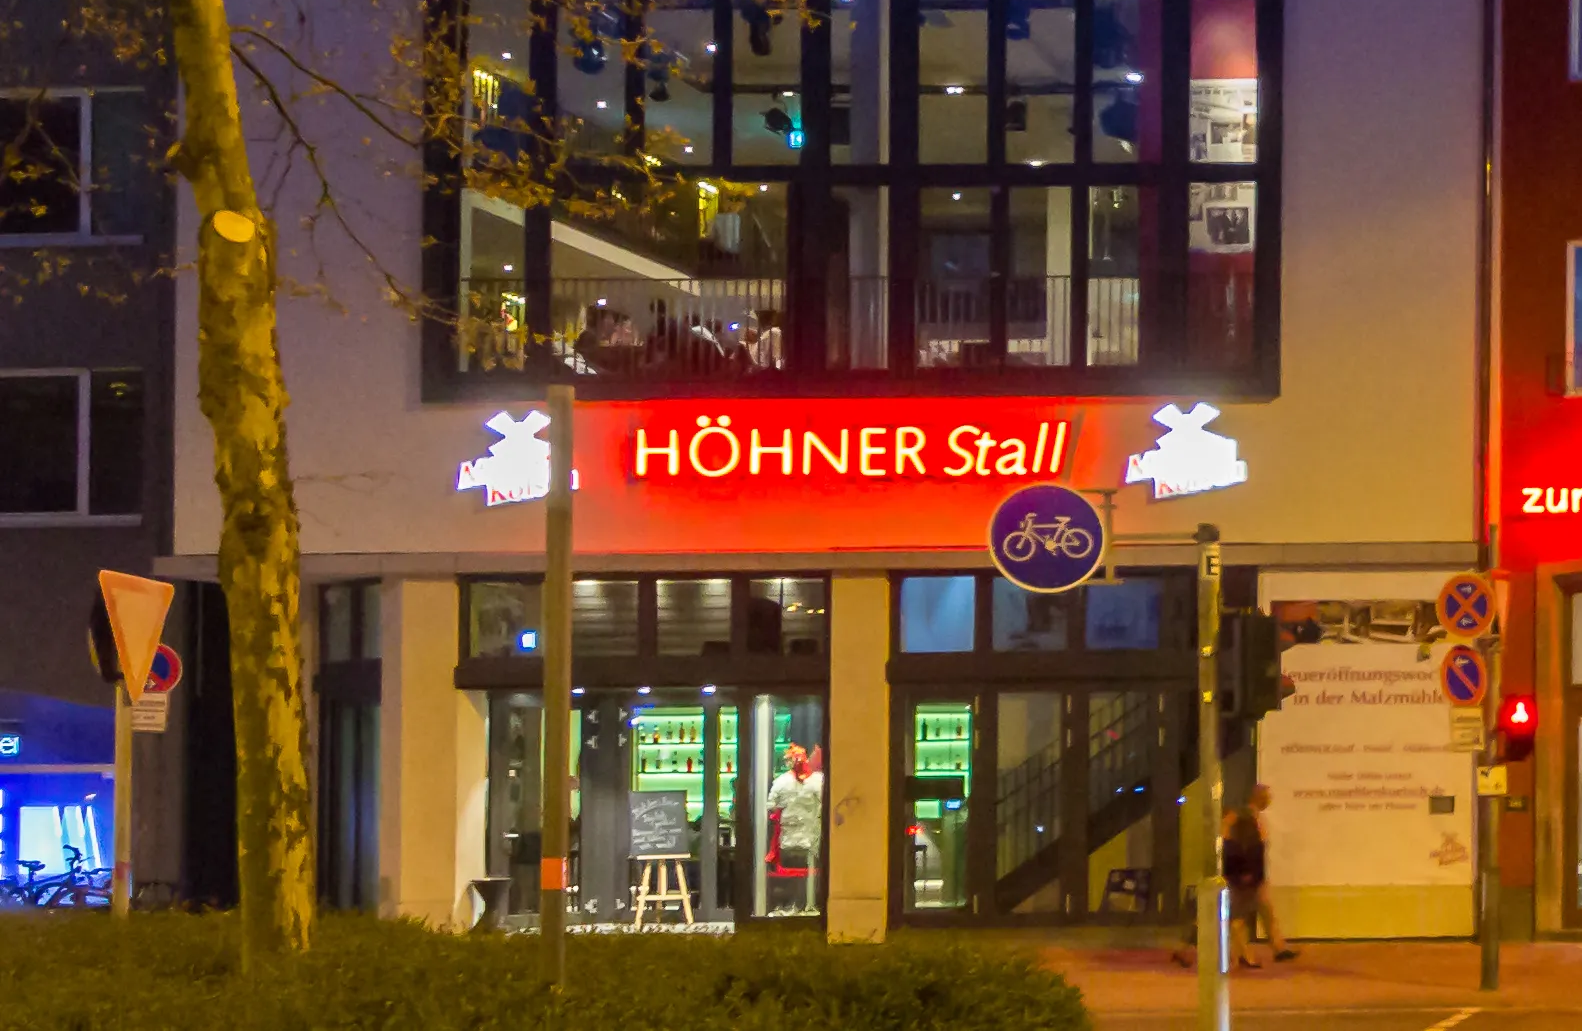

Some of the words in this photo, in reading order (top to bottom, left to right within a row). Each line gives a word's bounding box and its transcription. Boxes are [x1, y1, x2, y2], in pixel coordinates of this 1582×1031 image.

[635, 414, 927, 478] HÖHNER
[943, 421, 1067, 476] Stall
[1316, 689, 1344, 706] der
